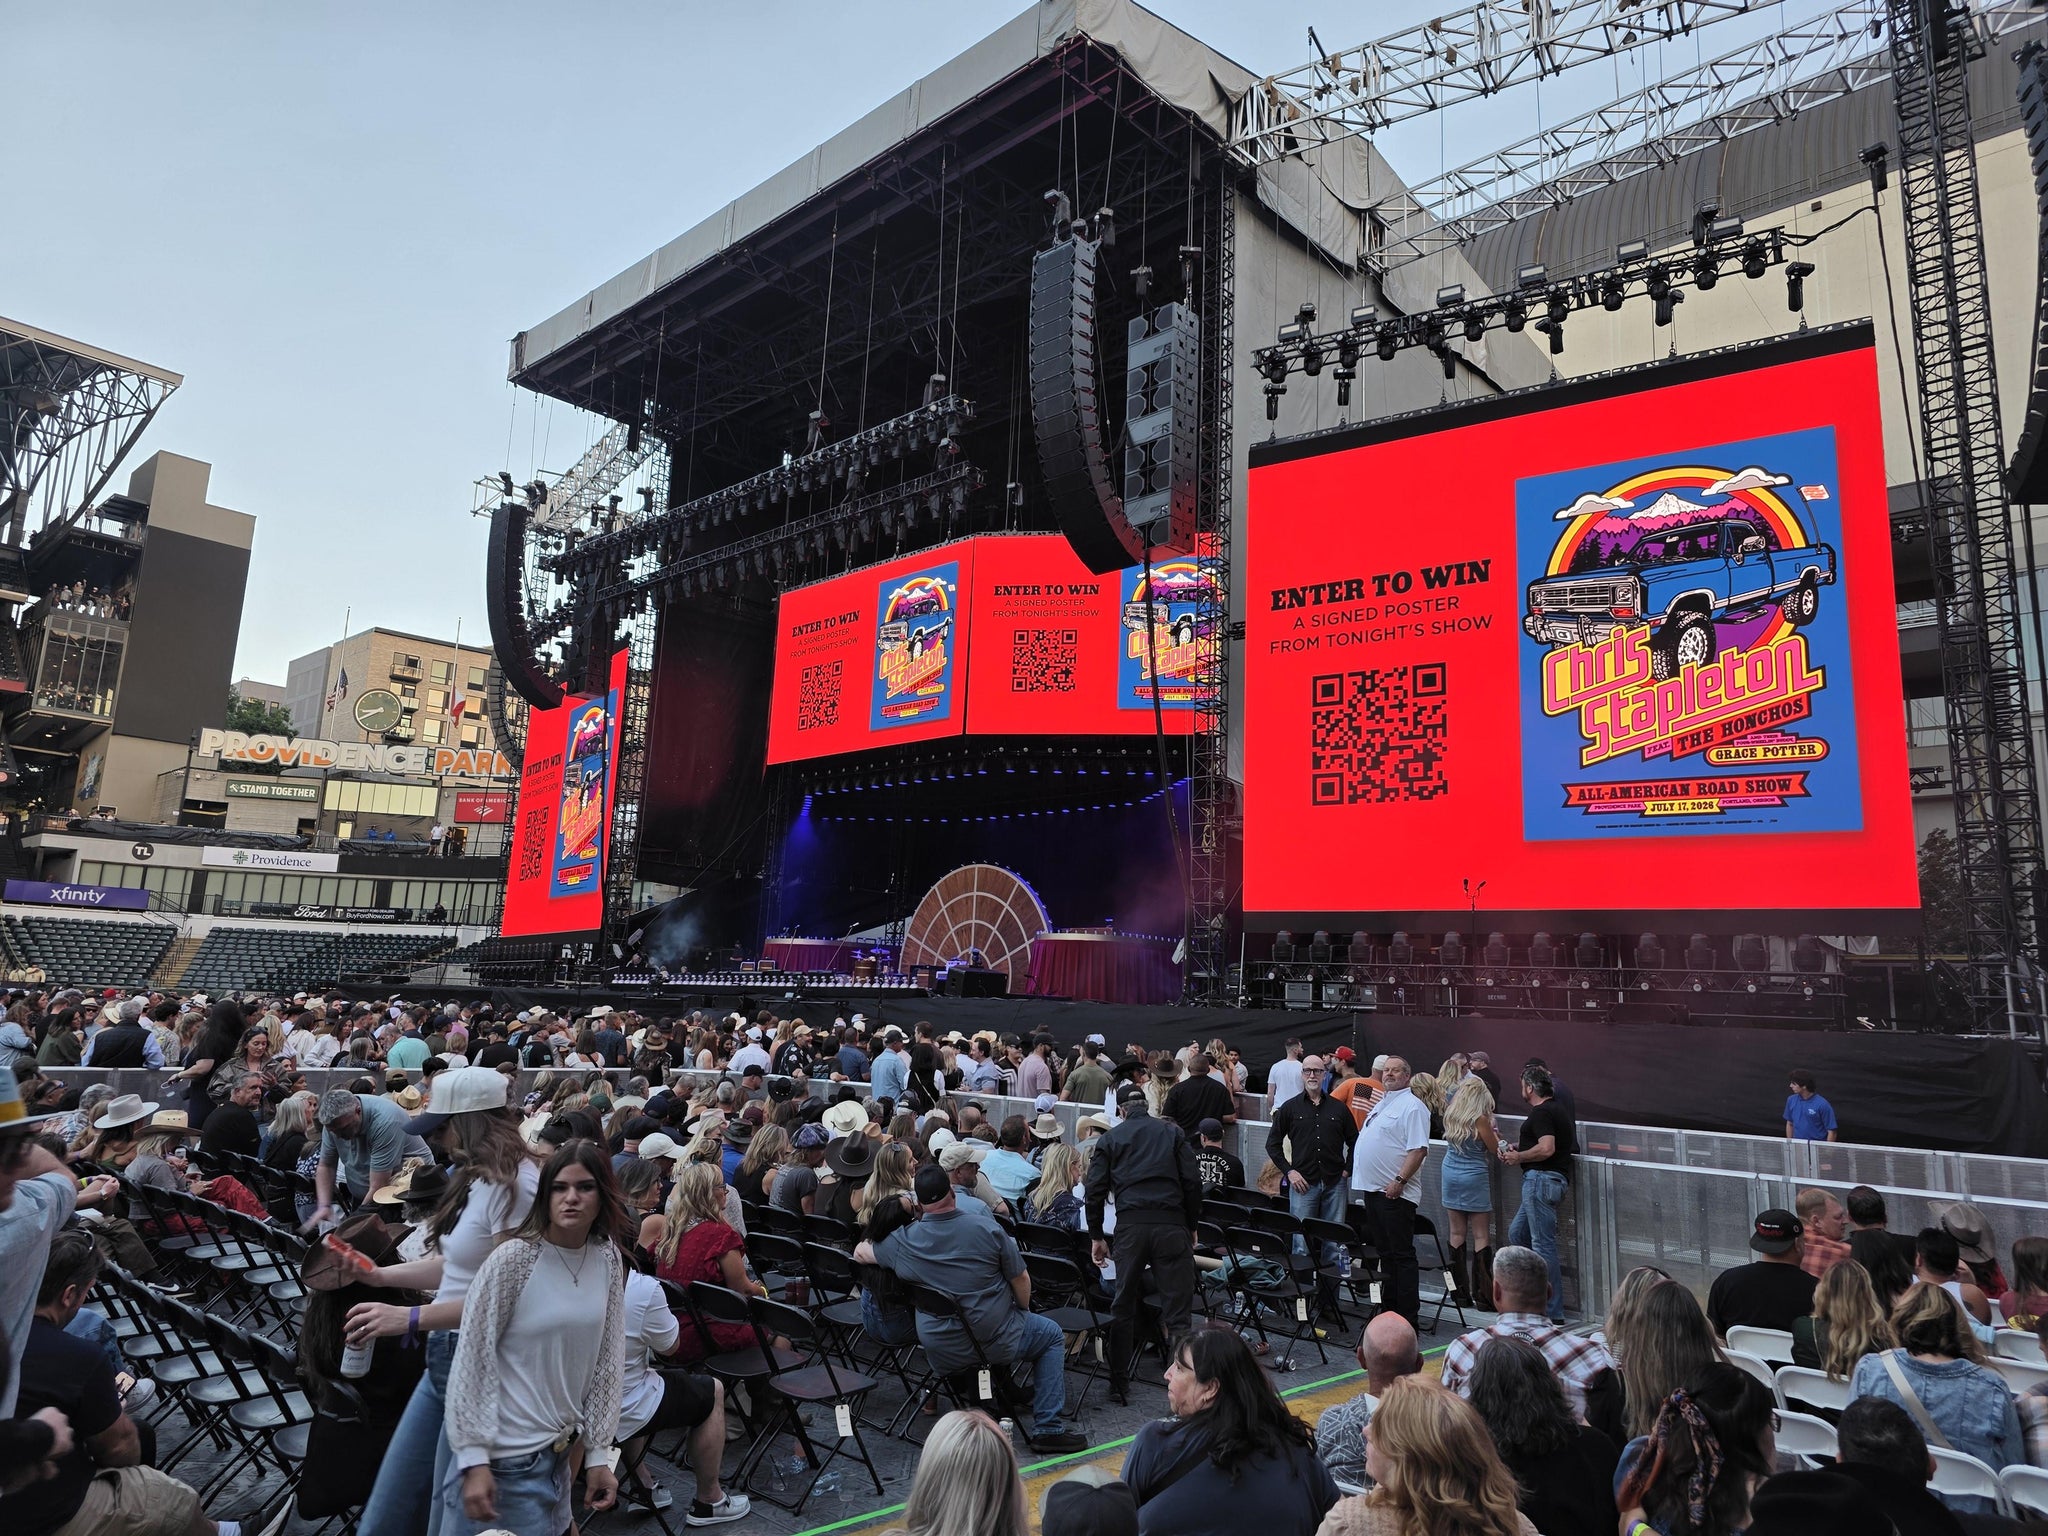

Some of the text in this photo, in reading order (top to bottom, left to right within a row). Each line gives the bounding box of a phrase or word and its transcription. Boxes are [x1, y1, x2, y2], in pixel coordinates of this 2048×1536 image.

[993, 584, 1100, 596] ENTER TO WIN
[1270, 558, 1491, 611] ENTER TO WIN
[792, 610, 860, 638] ENTER TO WIN
[1022, 609, 1068, 617] TONIGHT'S
[1071, 609, 1100, 617] SHOW
[1293, 596, 1460, 630] A SIGNED POSTER
[804, 633, 825, 646] SIGNED
[827, 628, 850, 639] POSTER
[1129, 625, 1171, 658] Chis
[1270, 614, 1493, 654] FROM TONIGHT'S SHOW
[790, 649, 807, 659] FROM
[839, 637, 858, 647] SHOW
[1545, 626, 1649, 713] Chris
[1584, 637, 1820, 759] Stapleton
[1647, 699, 1804, 755] FEAT. THE HONCHOS
[199, 728, 430, 775] PROVIDENCE
[1715, 744, 1817, 760] GRACE POTTER
[240, 783, 316, 798] STAND TOGETHER
[1577, 778, 1792, 801] ALL-AMERICAN ROAD SHOW
[1650, 801, 1714, 812] JULY 17, 2026
[134, 845, 151, 856] TL
[251, 853, 312, 867] Providence
[50, 886, 106, 904] xfinity
[294, 904, 327, 919] Ford
